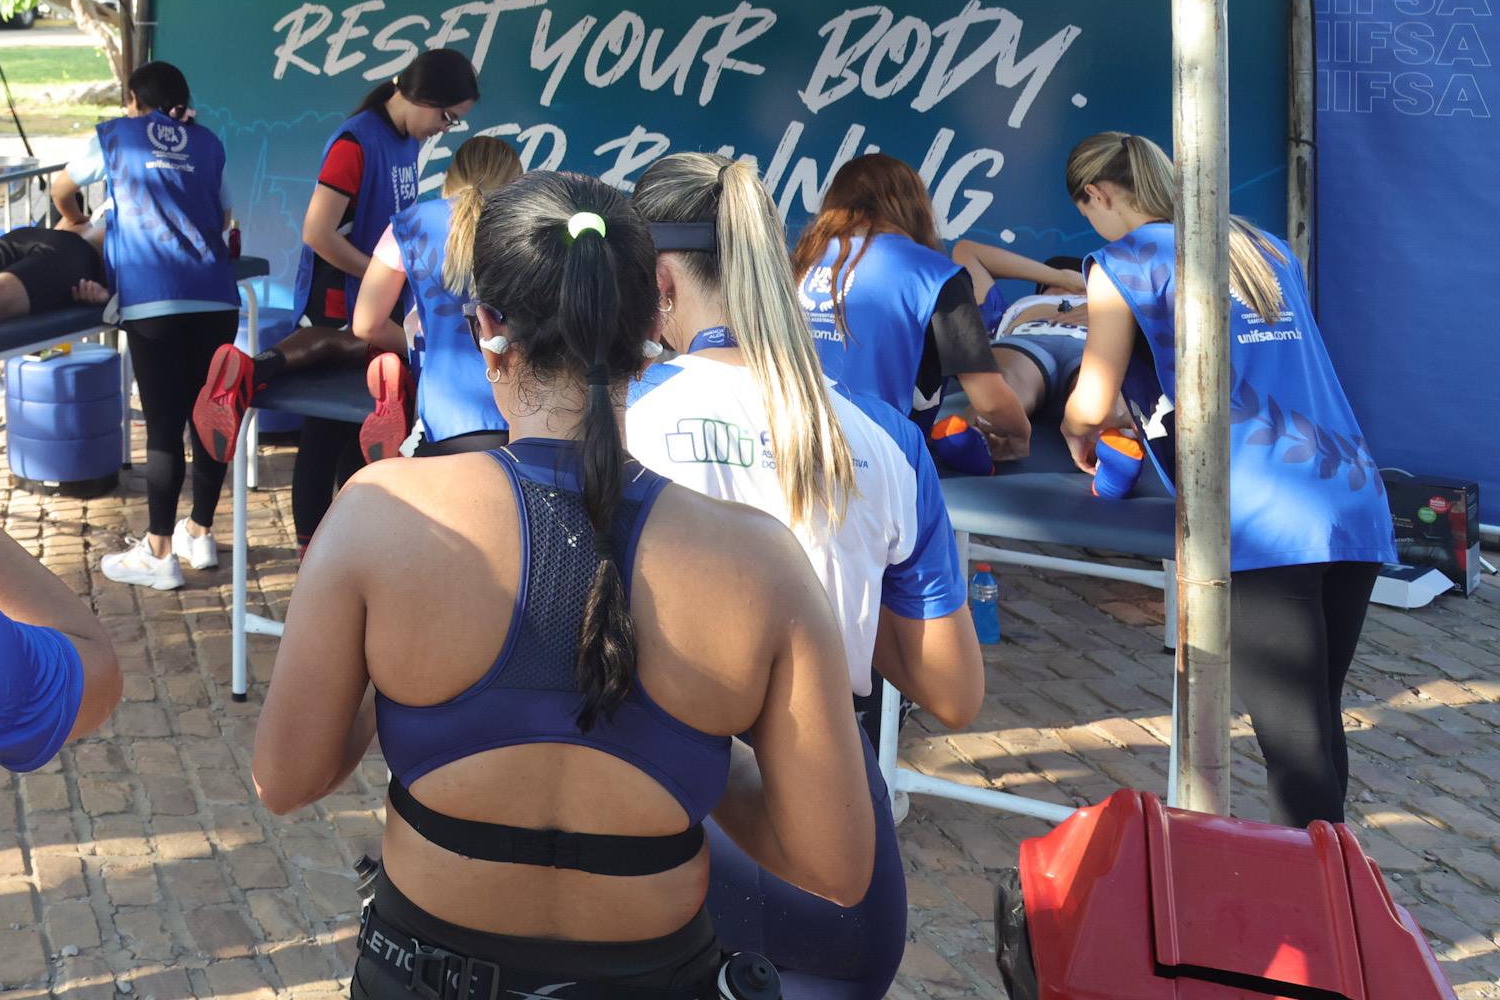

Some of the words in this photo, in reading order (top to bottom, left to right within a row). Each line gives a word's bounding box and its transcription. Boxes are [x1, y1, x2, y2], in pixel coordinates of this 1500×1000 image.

[530, 0, 778, 107] YOUR
[398, 165, 414, 184] UNI
[813, 266, 832, 281] UN
